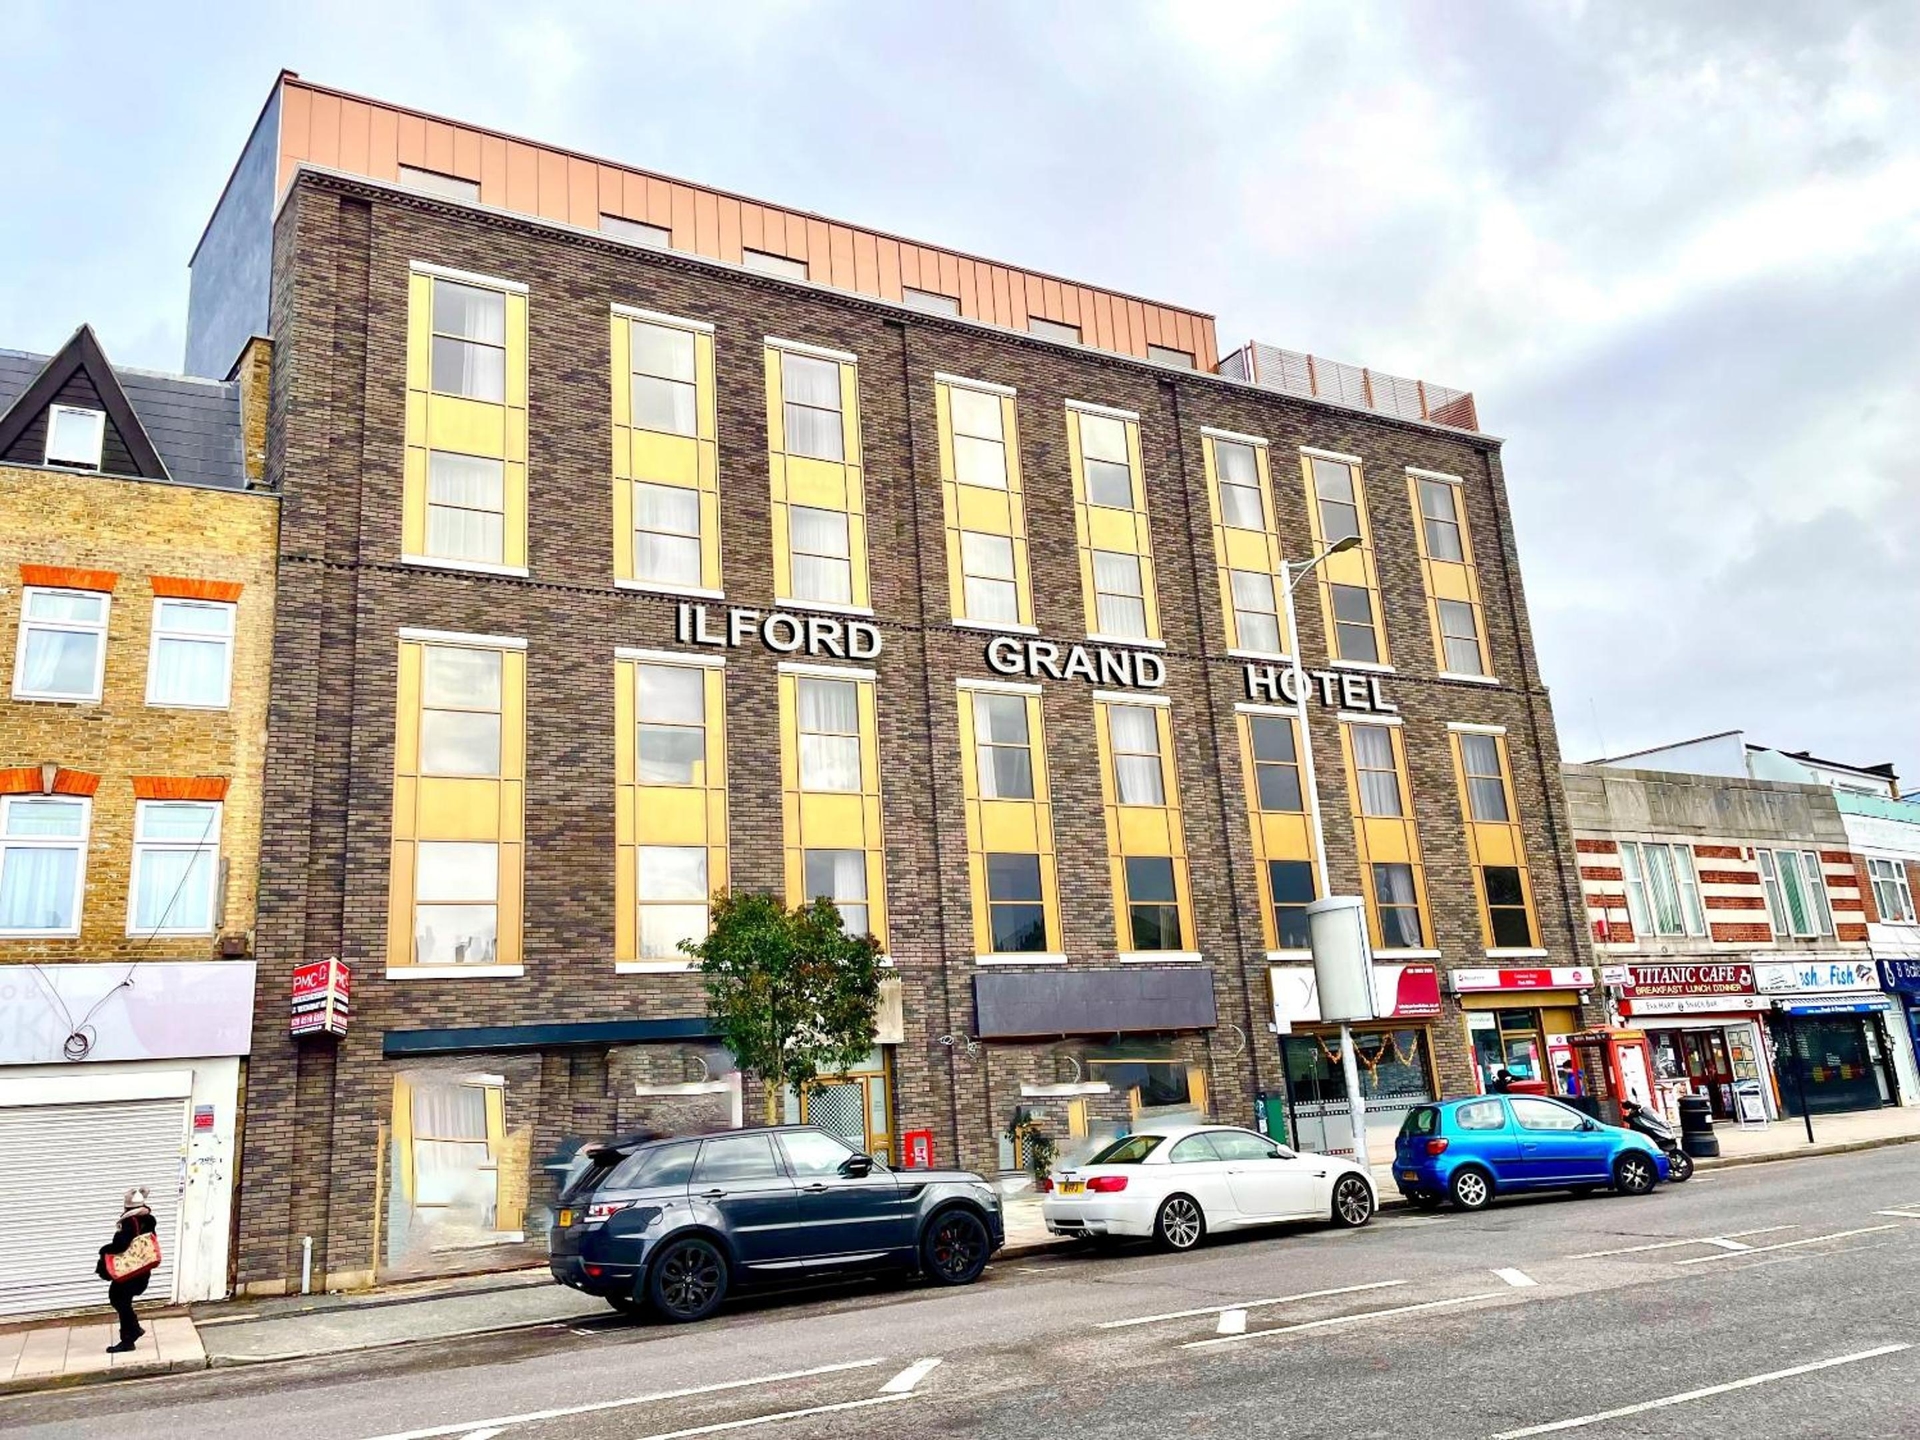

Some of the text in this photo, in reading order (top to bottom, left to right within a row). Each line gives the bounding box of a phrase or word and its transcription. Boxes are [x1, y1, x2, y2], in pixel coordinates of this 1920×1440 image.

[677, 602, 882, 660] ILFORD
[985, 635, 1167, 688] GRAND
[1244, 663, 1399, 713] HOTEL
[1636, 983, 1742, 995] BREAKFAST LUNCH DINNER
[1637, 967, 1696, 984] TITANIC
[1700, 967, 1736, 983] CAFE
[1830, 965, 1854, 985] Fish
